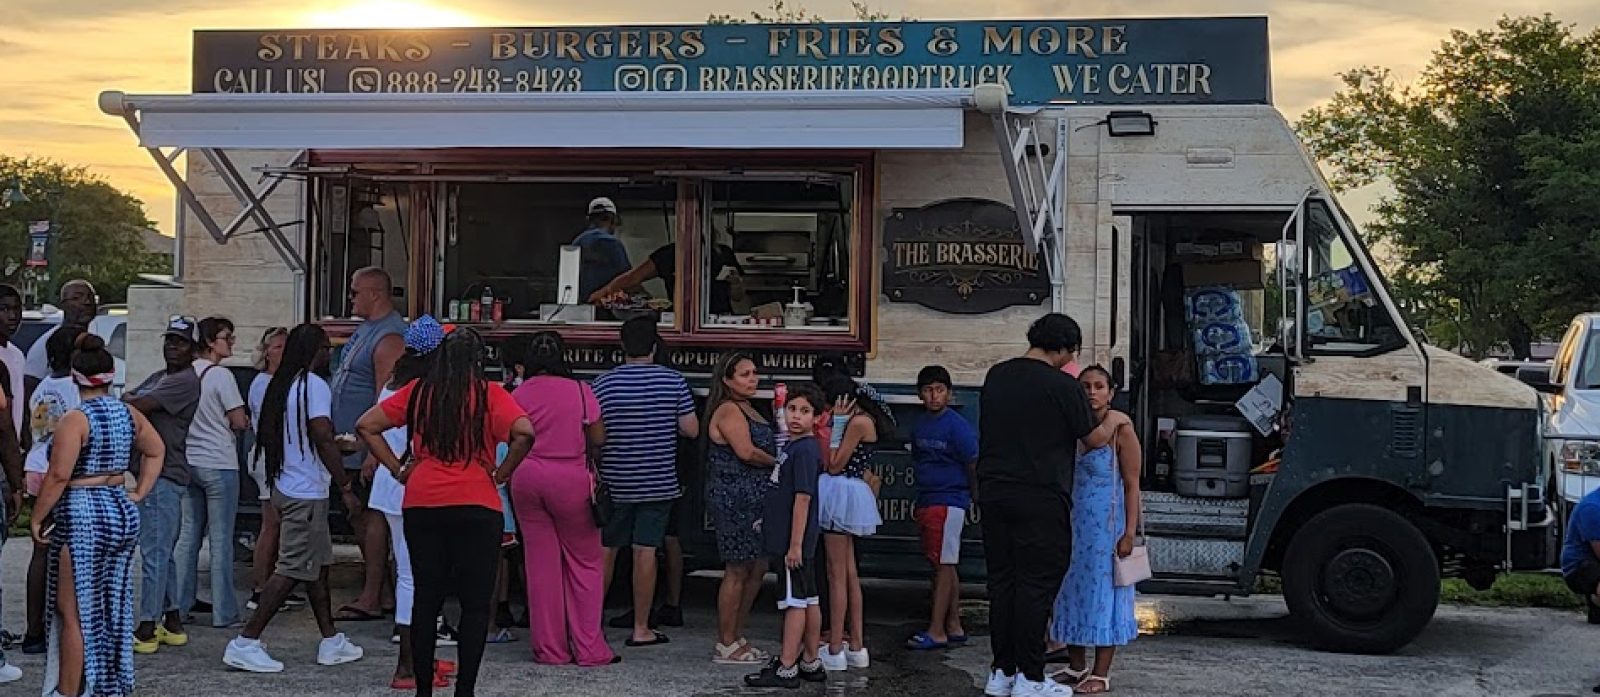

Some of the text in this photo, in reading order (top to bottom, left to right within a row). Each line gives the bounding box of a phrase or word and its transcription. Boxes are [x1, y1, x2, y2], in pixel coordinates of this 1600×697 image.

[257, 33, 432, 61] STEAKS
[492, 30, 705, 61] BURGERS
[768, 27, 905, 59] FRIES
[926, 27, 959, 56] &
[983, 25, 1128, 59] MORE
[213, 68, 325, 93] CALL US!
[387, 66, 582, 93] 888-243-8423
[1052, 63, 1212, 95] WE CATER
[893, 242, 1039, 271] THE BRASSERIE
